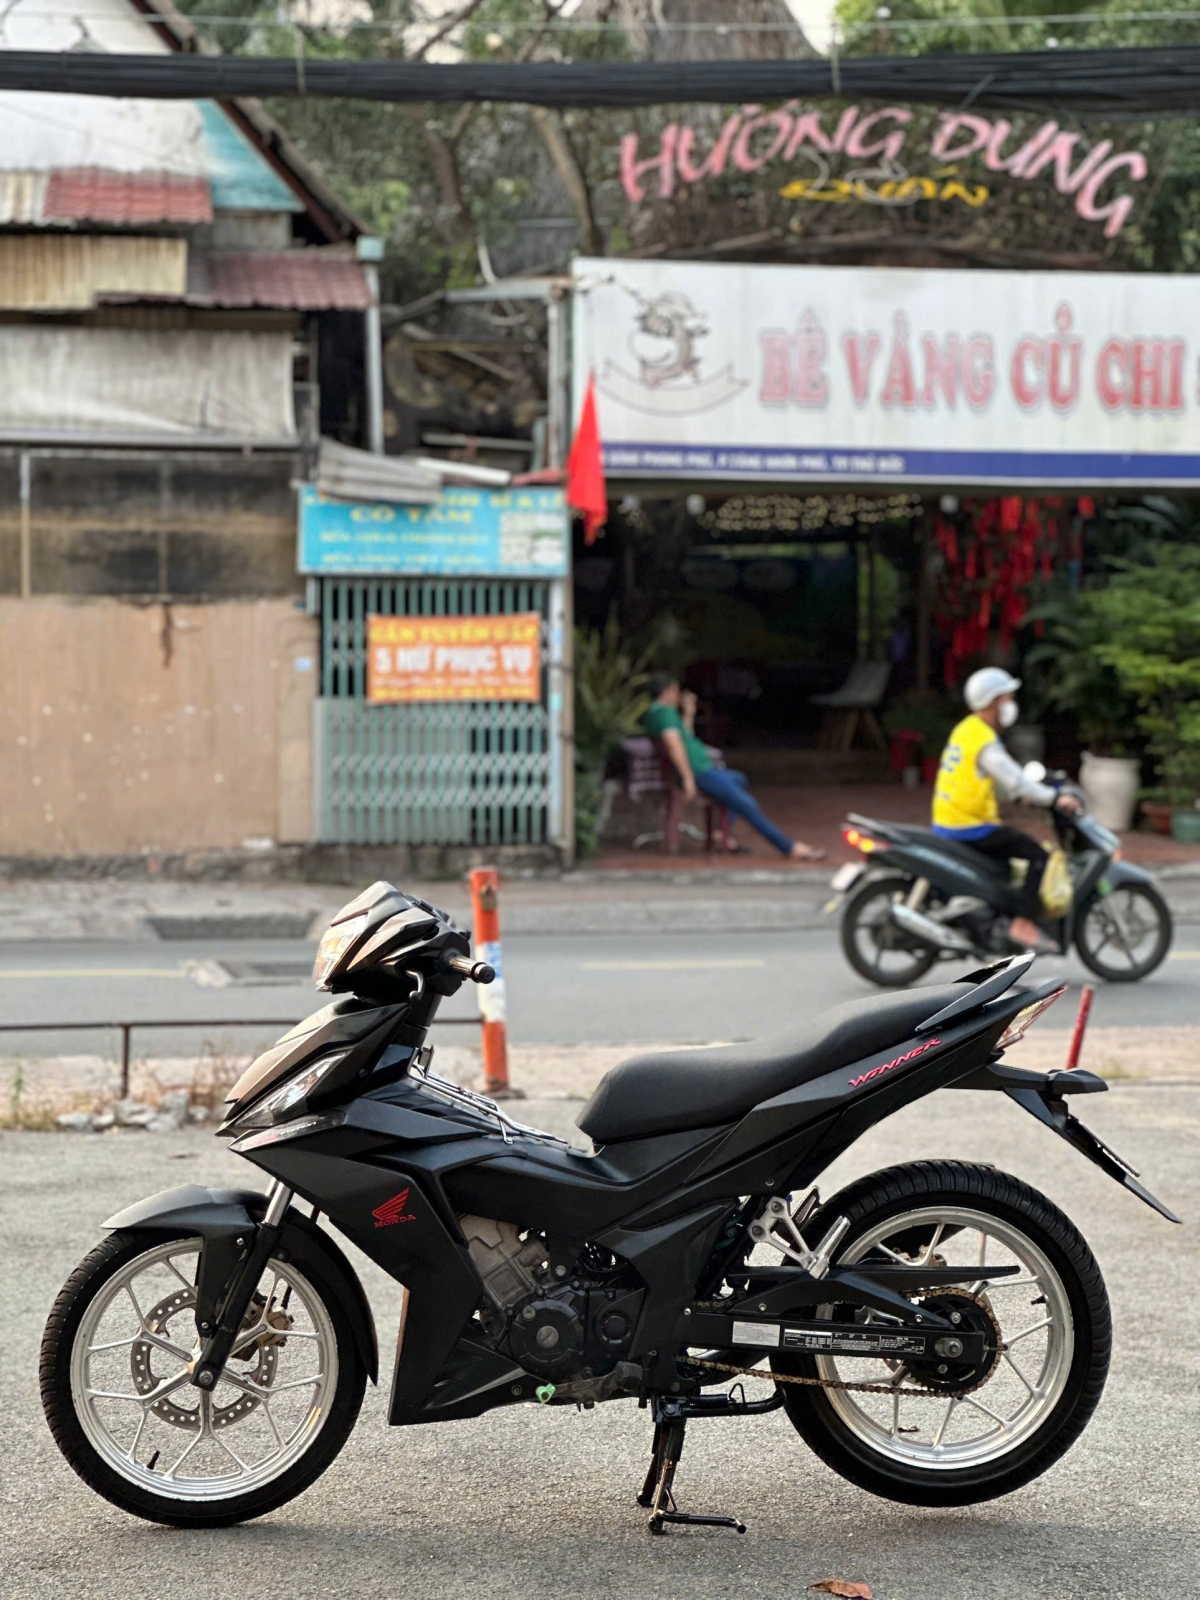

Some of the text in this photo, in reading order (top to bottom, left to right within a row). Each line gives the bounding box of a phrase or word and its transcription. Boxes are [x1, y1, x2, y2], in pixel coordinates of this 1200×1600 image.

[1008, 302, 1082, 410] CỦ
[1096, 339, 1184, 411] CHI
[848, 1038, 941, 1087] WINNER
[373, 1214, 417, 1228] HONDA
